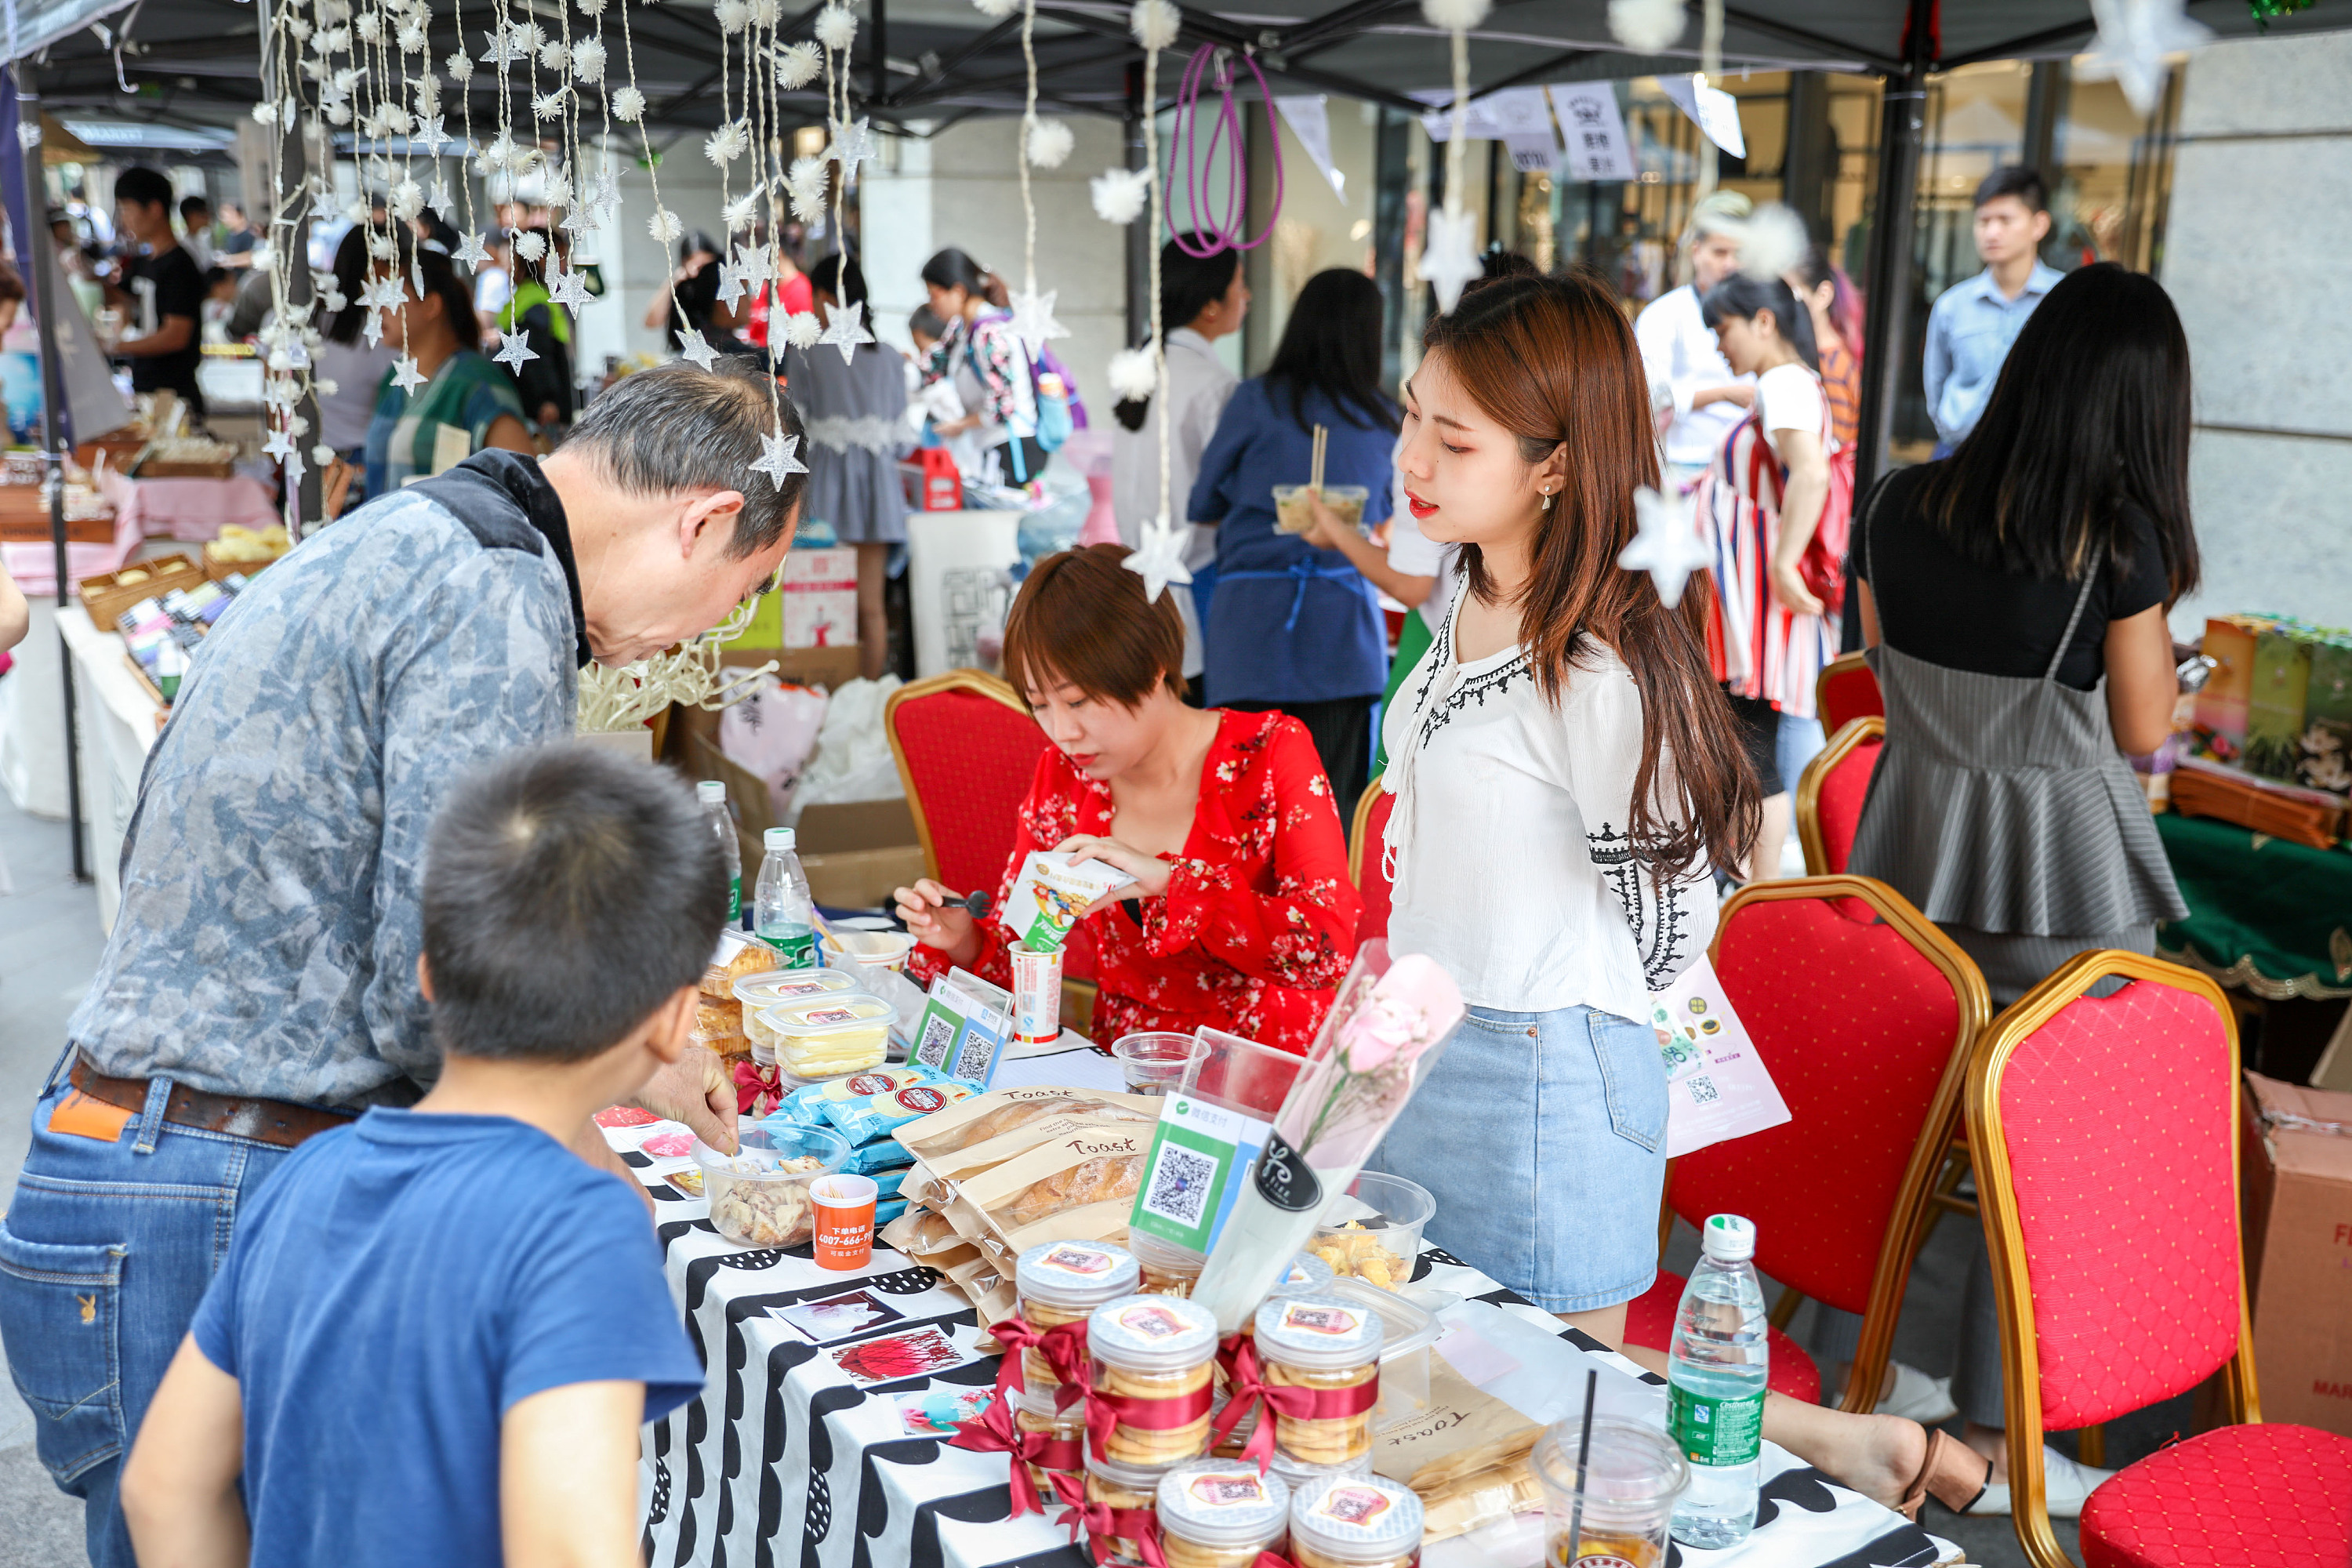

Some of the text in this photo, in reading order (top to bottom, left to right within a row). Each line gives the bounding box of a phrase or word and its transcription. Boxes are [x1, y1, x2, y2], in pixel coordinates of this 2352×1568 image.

[1664, 1046, 1687, 1063] 50
[1001, 1090, 1073, 1099] Toast
[1039, 1123, 1052, 1132] Find
[1065, 1138, 1136, 1155] Toast
[831, 1225, 866, 1236] 下单电话
[830, 1248, 865, 1257] 可现金支付
[1387, 1411, 1472, 1446] Toast
